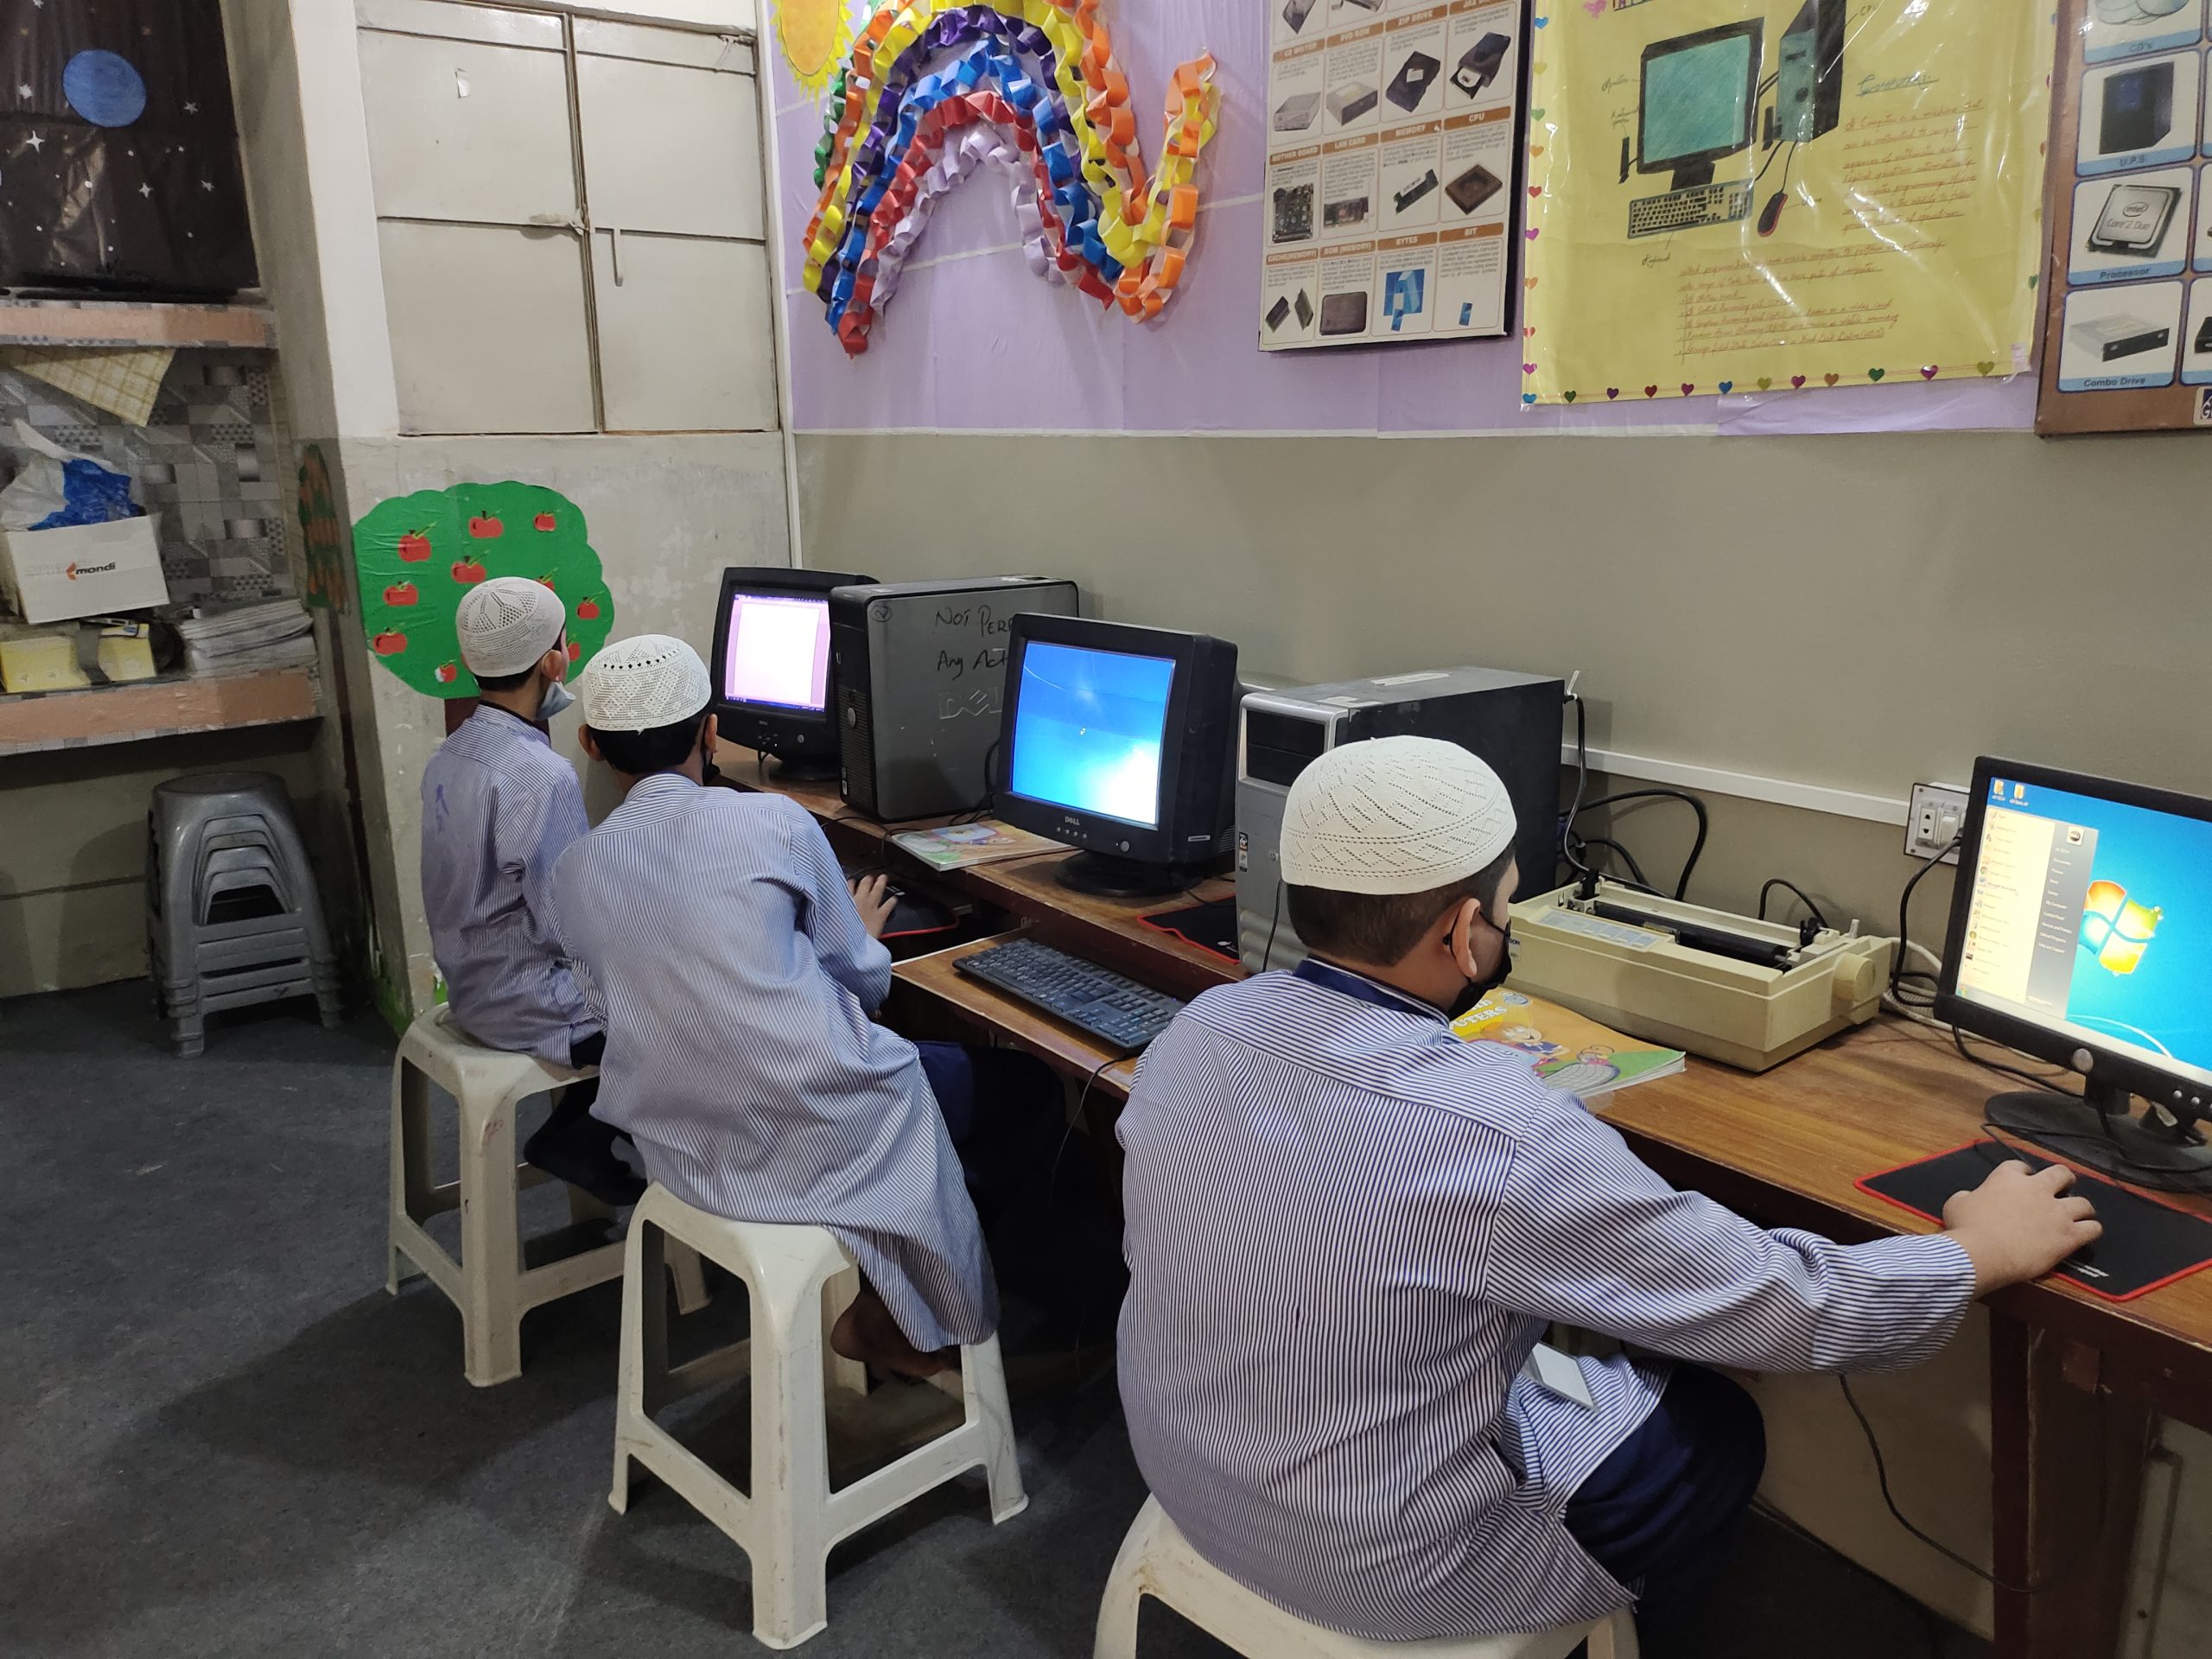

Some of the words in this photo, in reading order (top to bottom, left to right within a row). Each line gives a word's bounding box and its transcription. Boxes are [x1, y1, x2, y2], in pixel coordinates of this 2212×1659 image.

[1397, 13, 1413, 25] ZIP
[1414, 10, 1433, 22] DRIVE
[1469, 112, 1484, 122] CPU
[1395, 124, 1426, 137] MEMORY
[1334, 139, 1349, 149] LAN
[1350, 137, 1365, 147] CARD
[1273, 149, 1298, 162] MOTHER
[2120, 156, 2145, 167] U.P.S
[2126, 204, 2145, 213] intel
[2107, 218, 2125, 229] Core
[2125, 220, 2133, 229] 2
[2133, 220, 2151, 230] Duo
[1465, 227, 1478, 237] BIT
[1396, 236, 1418, 245] BYTES
[1324, 245, 1339, 256] ROM
[1339, 242, 1371, 254] (MEMORY)
[2100, 267, 2151, 280] Processor
[2084, 378, 2118, 388] Combo
[2120, 376, 2146, 386] Drive
[75, 562, 116, 575] mondi
[978, 604, 1014, 638] PER
[938, 650, 963, 681] Any
[973, 649, 1007, 670] Act
[940, 687, 1002, 720] DEL
[1065, 816, 1080, 826] DELL
